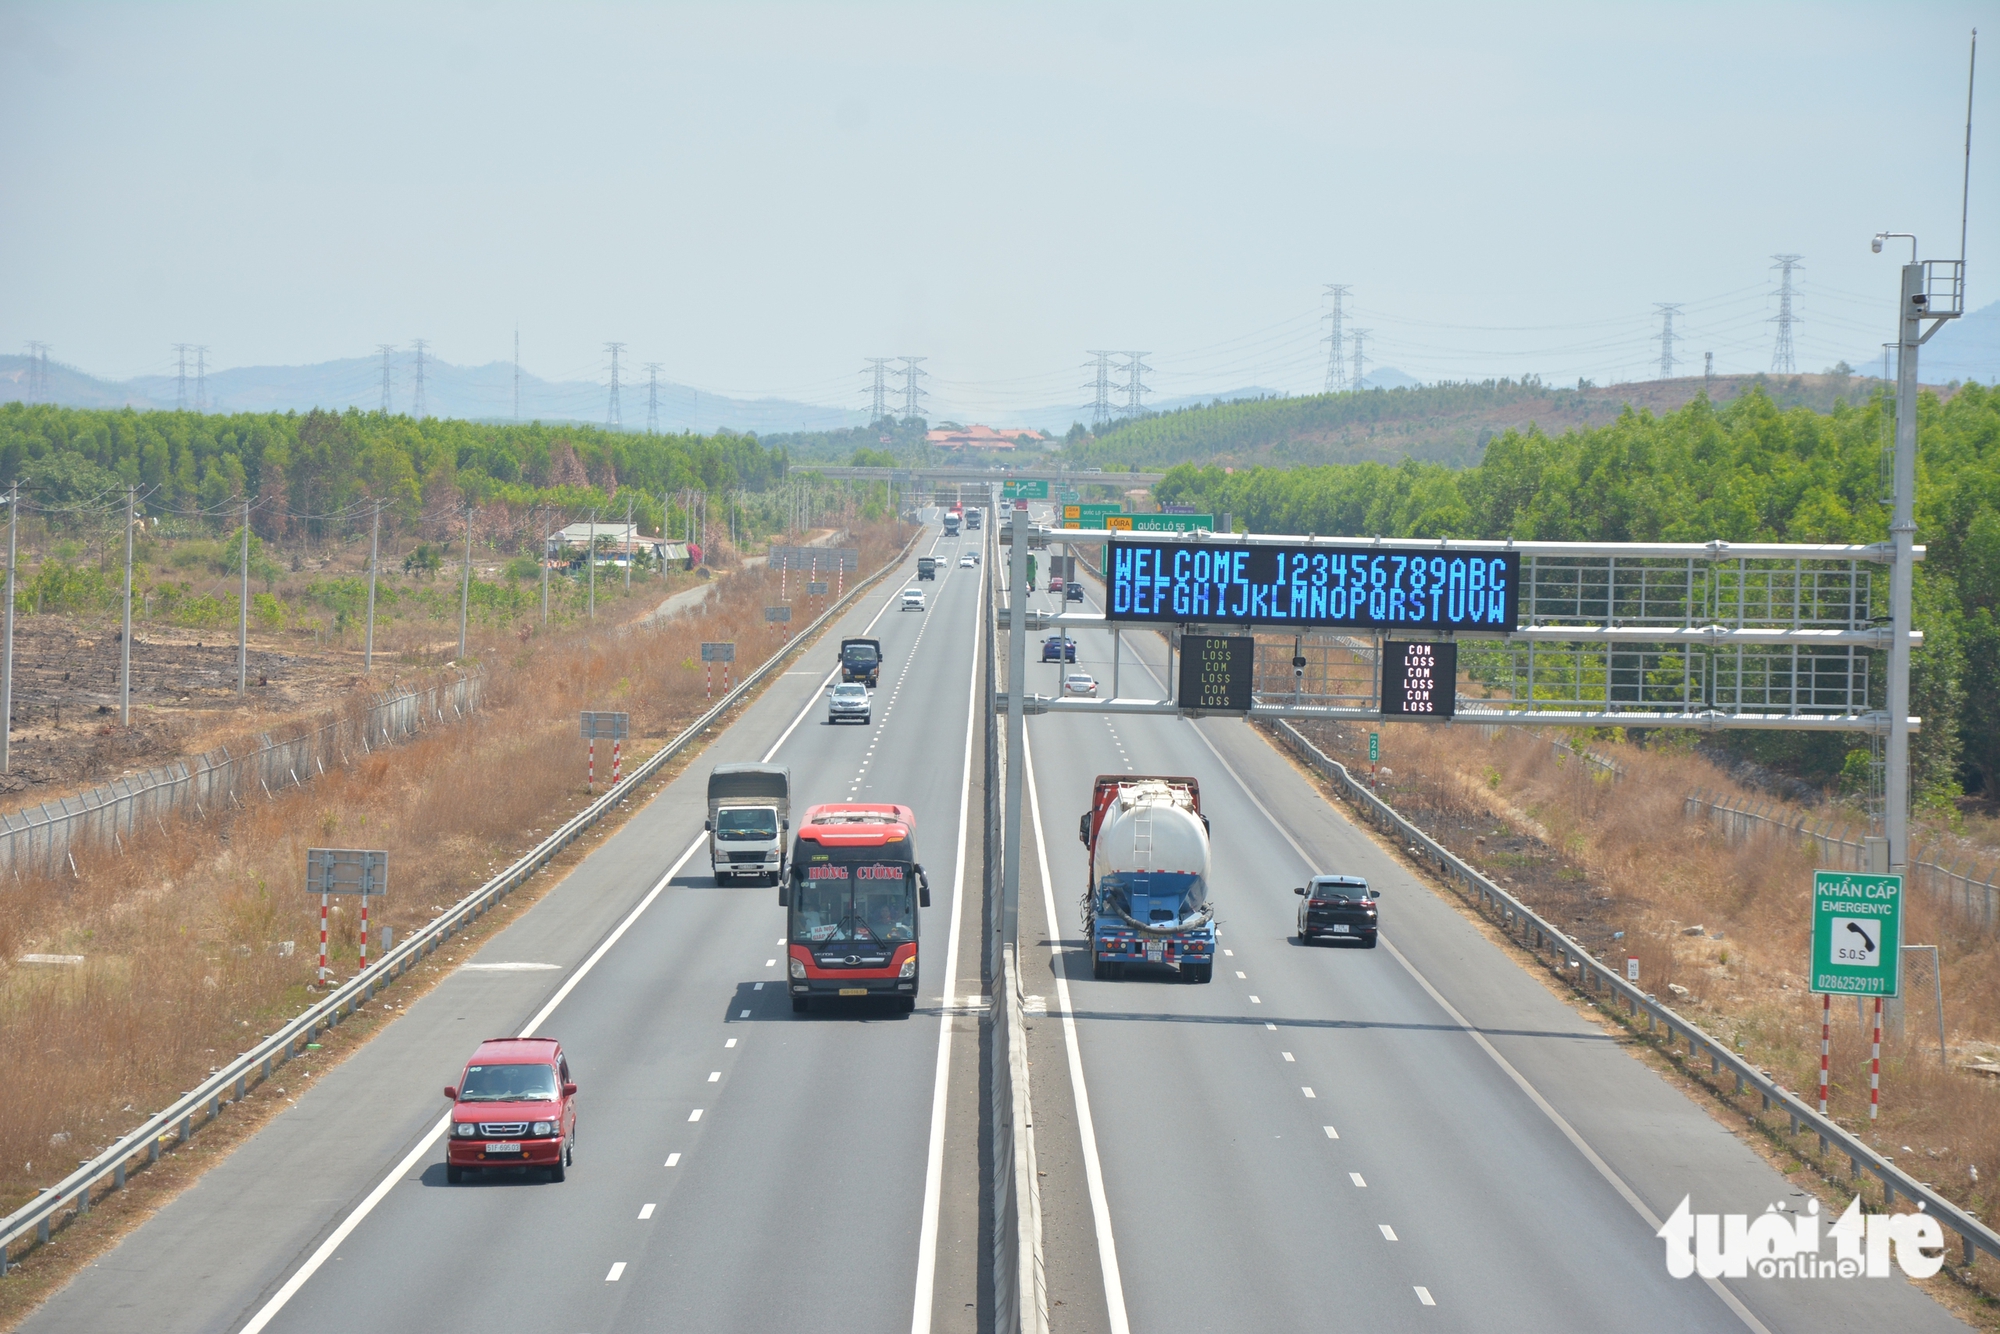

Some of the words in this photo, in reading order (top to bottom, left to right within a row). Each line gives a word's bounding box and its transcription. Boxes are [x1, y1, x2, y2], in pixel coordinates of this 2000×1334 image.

[1137, 518, 1161, 531] QUỐC
[1163, 520, 1174, 532] LỘ
[1175, 523, 1186, 531] 55
[1115, 548, 1251, 585] WELCOME
[1276, 553, 1508, 591] 123456789ABC
[1114, 581, 1506, 623] DEFGHIJKLMNOPQRSTUVW
[1207, 640, 1227, 648] COM
[1409, 645, 1430, 655] COM
[1203, 651, 1230, 660] LOSS
[1405, 656, 1434, 666] LOSS
[1206, 662, 1226, 671] COM
[1408, 667, 1430, 677] COM
[1202, 674, 1230, 683] LOSS
[1404, 678, 1433, 689] LOSS
[1205, 685, 1225, 694] COM
[1407, 690, 1429, 700] COM
[1201, 696, 1229, 705] LOSS
[1403, 701, 1432, 711] LOSS
[1818, 877, 1862, 898] KHẨN
[1866, 880, 1897, 899] CẤP
[1822, 901, 1892, 915] EMERGENYC
[1818, 974, 1885, 991] 02862529191
